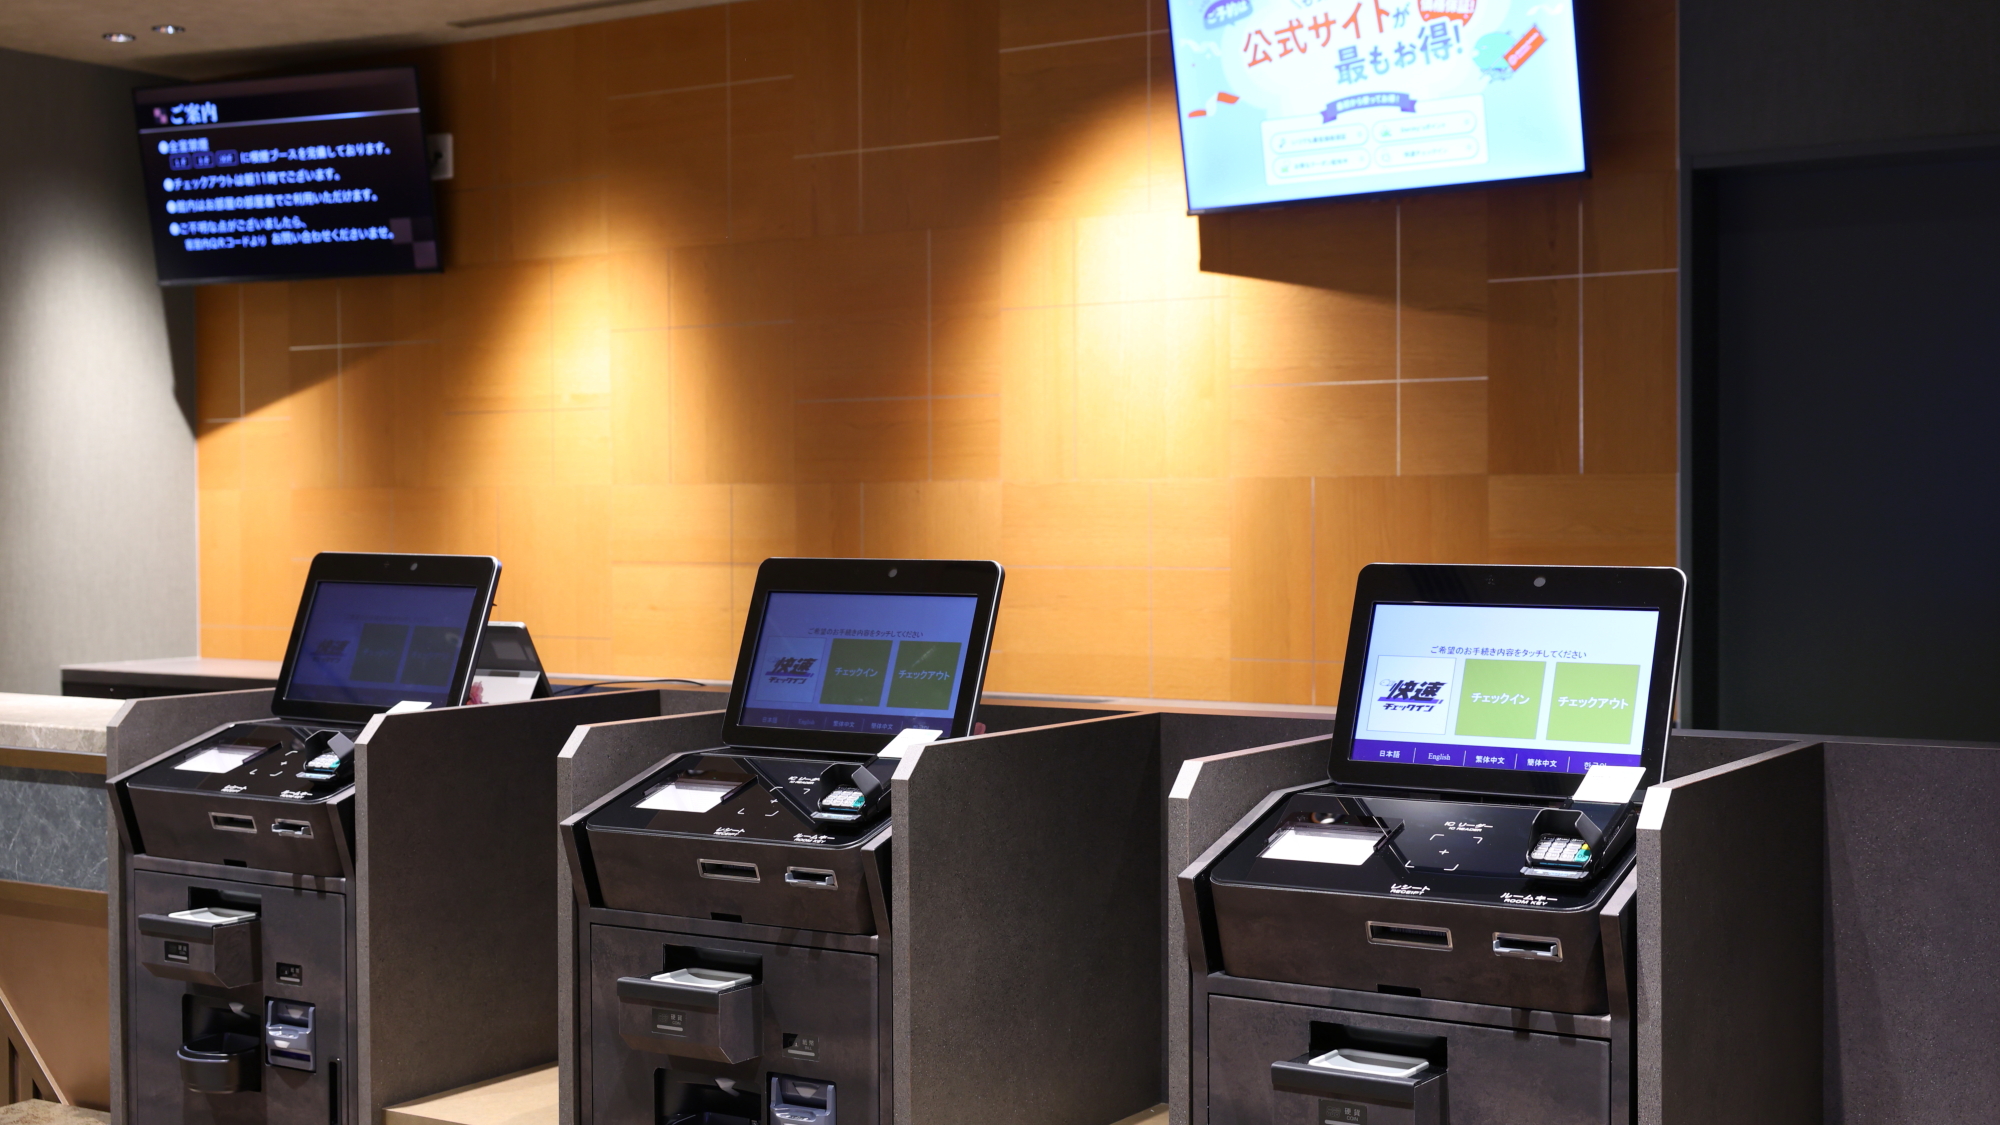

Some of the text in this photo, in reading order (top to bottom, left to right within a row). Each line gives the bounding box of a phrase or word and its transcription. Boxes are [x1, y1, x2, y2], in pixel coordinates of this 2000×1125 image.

[1243, 0, 1410, 68] 公式サイトが
[1334, 21, 1464, 85] 最もお得!
[170, 100, 219, 125] ご案内
[808, 628, 923, 638] ご希望のお手続き内容をタッチしてください
[1431, 646, 1587, 659] ご希望のお手続き内容をタッチしてください
[771, 656, 819, 674] 快速
[834, 666, 878, 677] チェックイン
[898, 669, 950, 681] チェックアウト
[768, 676, 808, 685] チェックイン
[1386, 680, 1447, 701] 快速
[1471, 692, 1530, 706] チェックイン
[1557, 695, 1630, 710] チェックアウト
[1383, 703, 1435, 713] チェックイン
[761, 716, 778, 724] 日本語
[1379, 749, 1401, 759] 日本語
[1428, 752, 1452, 762] English
[1475, 754, 1506, 765] 繁体中文
[1391, 883, 1431, 892] レシート
[1500, 892, 1558, 902] ルームキー
